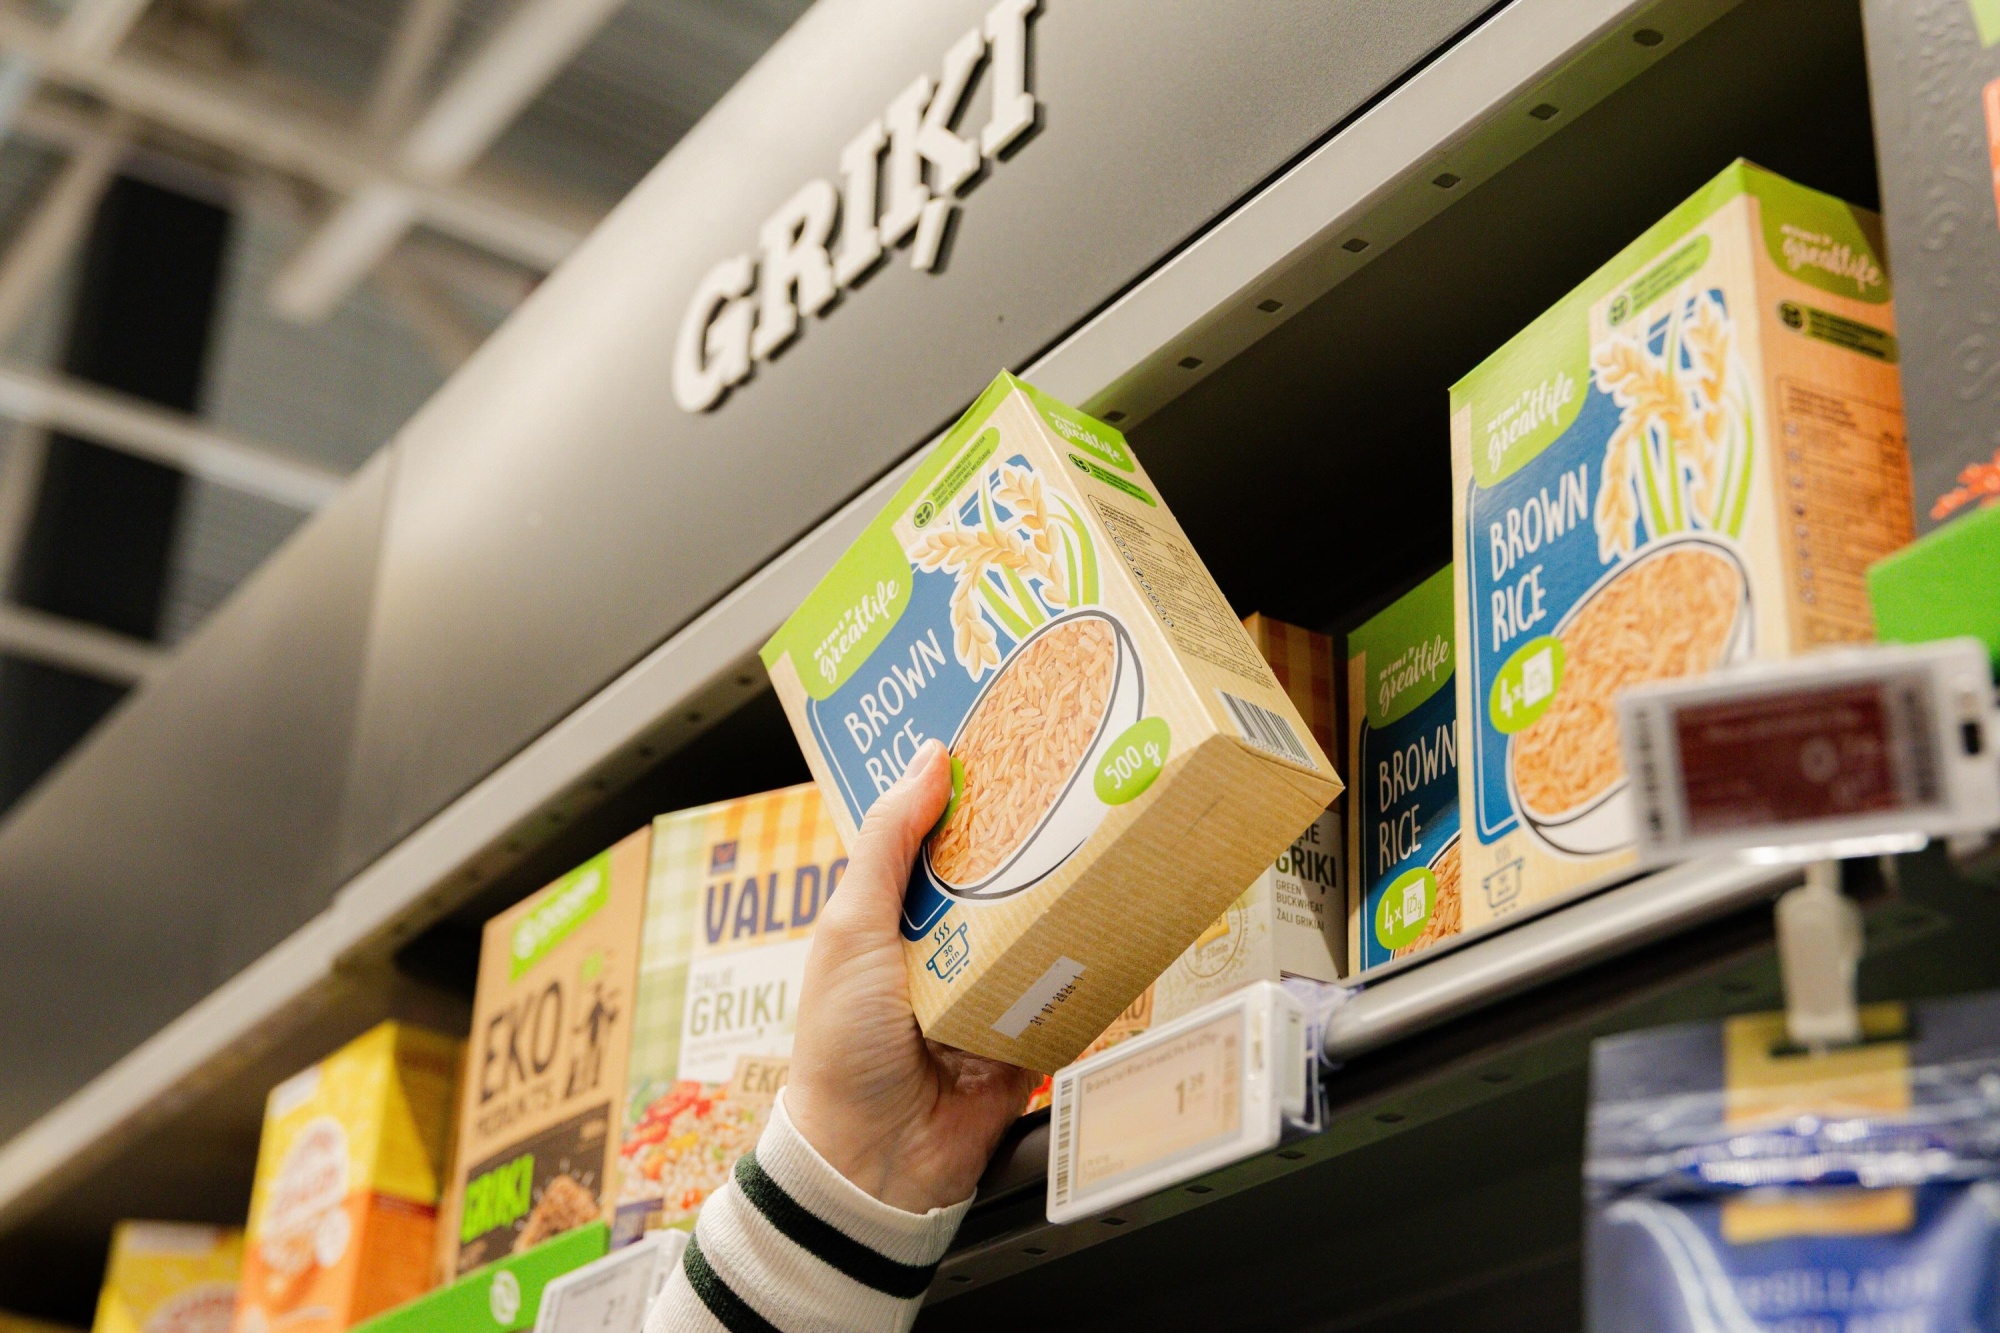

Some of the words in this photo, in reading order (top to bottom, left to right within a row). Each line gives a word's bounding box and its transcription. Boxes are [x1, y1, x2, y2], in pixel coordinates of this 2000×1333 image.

[672, 0, 1036, 412] GRIĶI
[1487, 372, 1578, 475] greatlife
[1489, 463, 1587, 582] BROWN
[820, 579, 899, 685] greatlife
[1491, 565, 1547, 653] RICE
[843, 628, 947, 755] BROWN
[1379, 633, 1451, 718] greatlife
[1104, 745, 1142, 790] 500
[1144, 739, 1162, 768] g
[1379, 719, 1457, 814] BROWN
[1275, 846, 1337, 896] GRIĶI
[1379, 804, 1422, 876] RICE
[1275, 880, 1302, 896] GREEN
[1276, 892, 1323, 915] BUCKWHEAT
[1277, 907, 1294, 923] ŽALI
[942, 944, 954, 958] 30
[945, 950, 961, 968] min
[689, 979, 787, 1038] GRIĶI
[1030, 1015, 1046, 1026] 31
[1052, 983, 1077, 1003] 2026
[479, 980, 564, 1104] EKO
